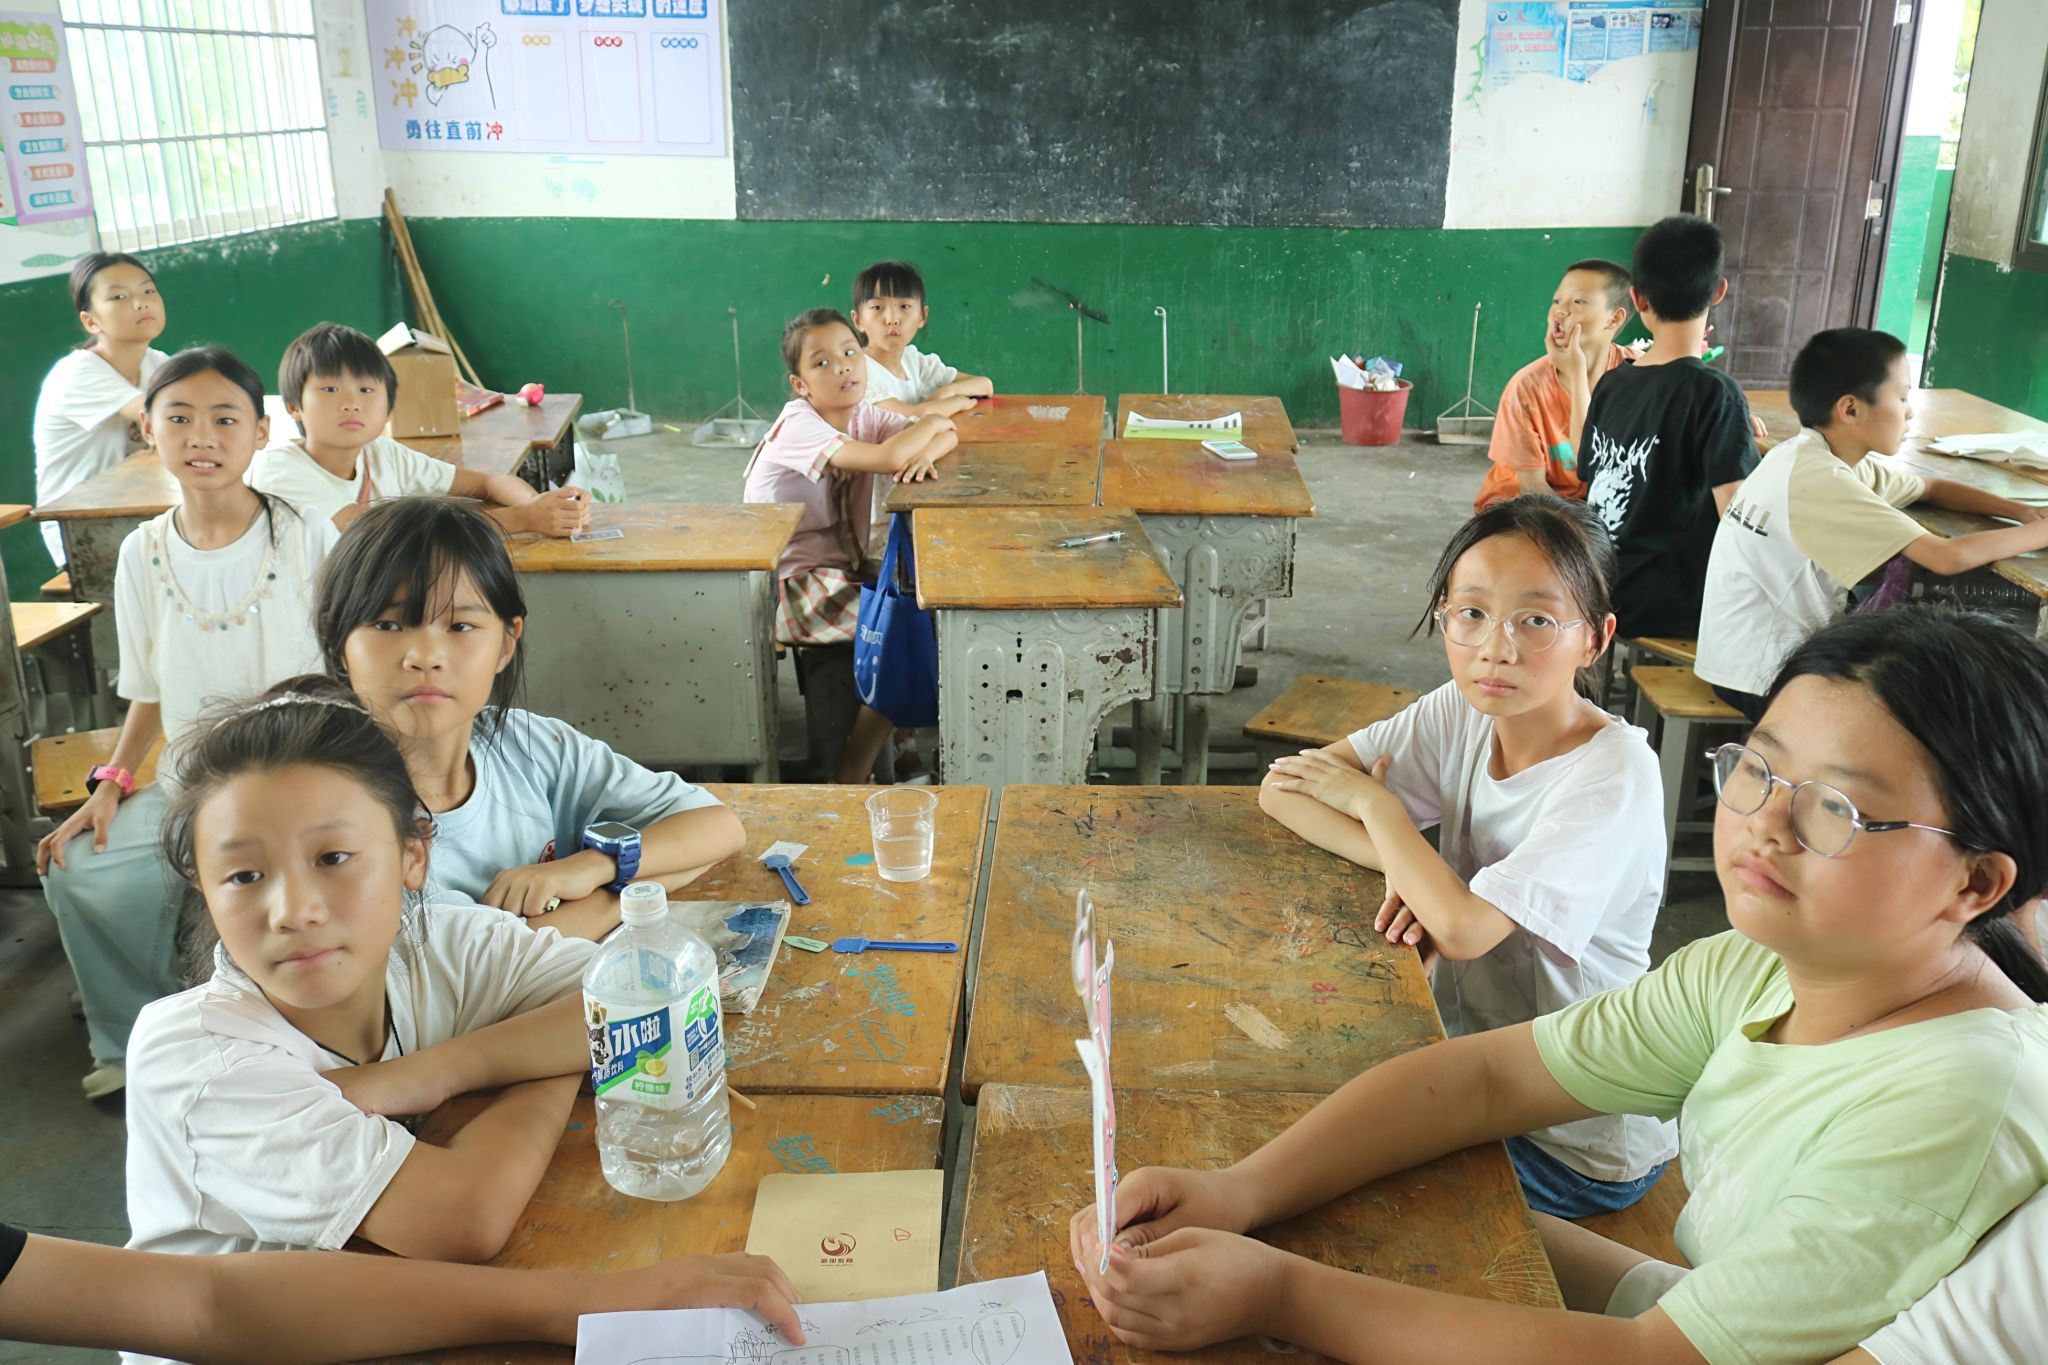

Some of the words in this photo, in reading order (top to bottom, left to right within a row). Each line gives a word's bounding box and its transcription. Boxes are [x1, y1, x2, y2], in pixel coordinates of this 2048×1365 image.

[405, 119, 504, 141] 勇往直前冲
